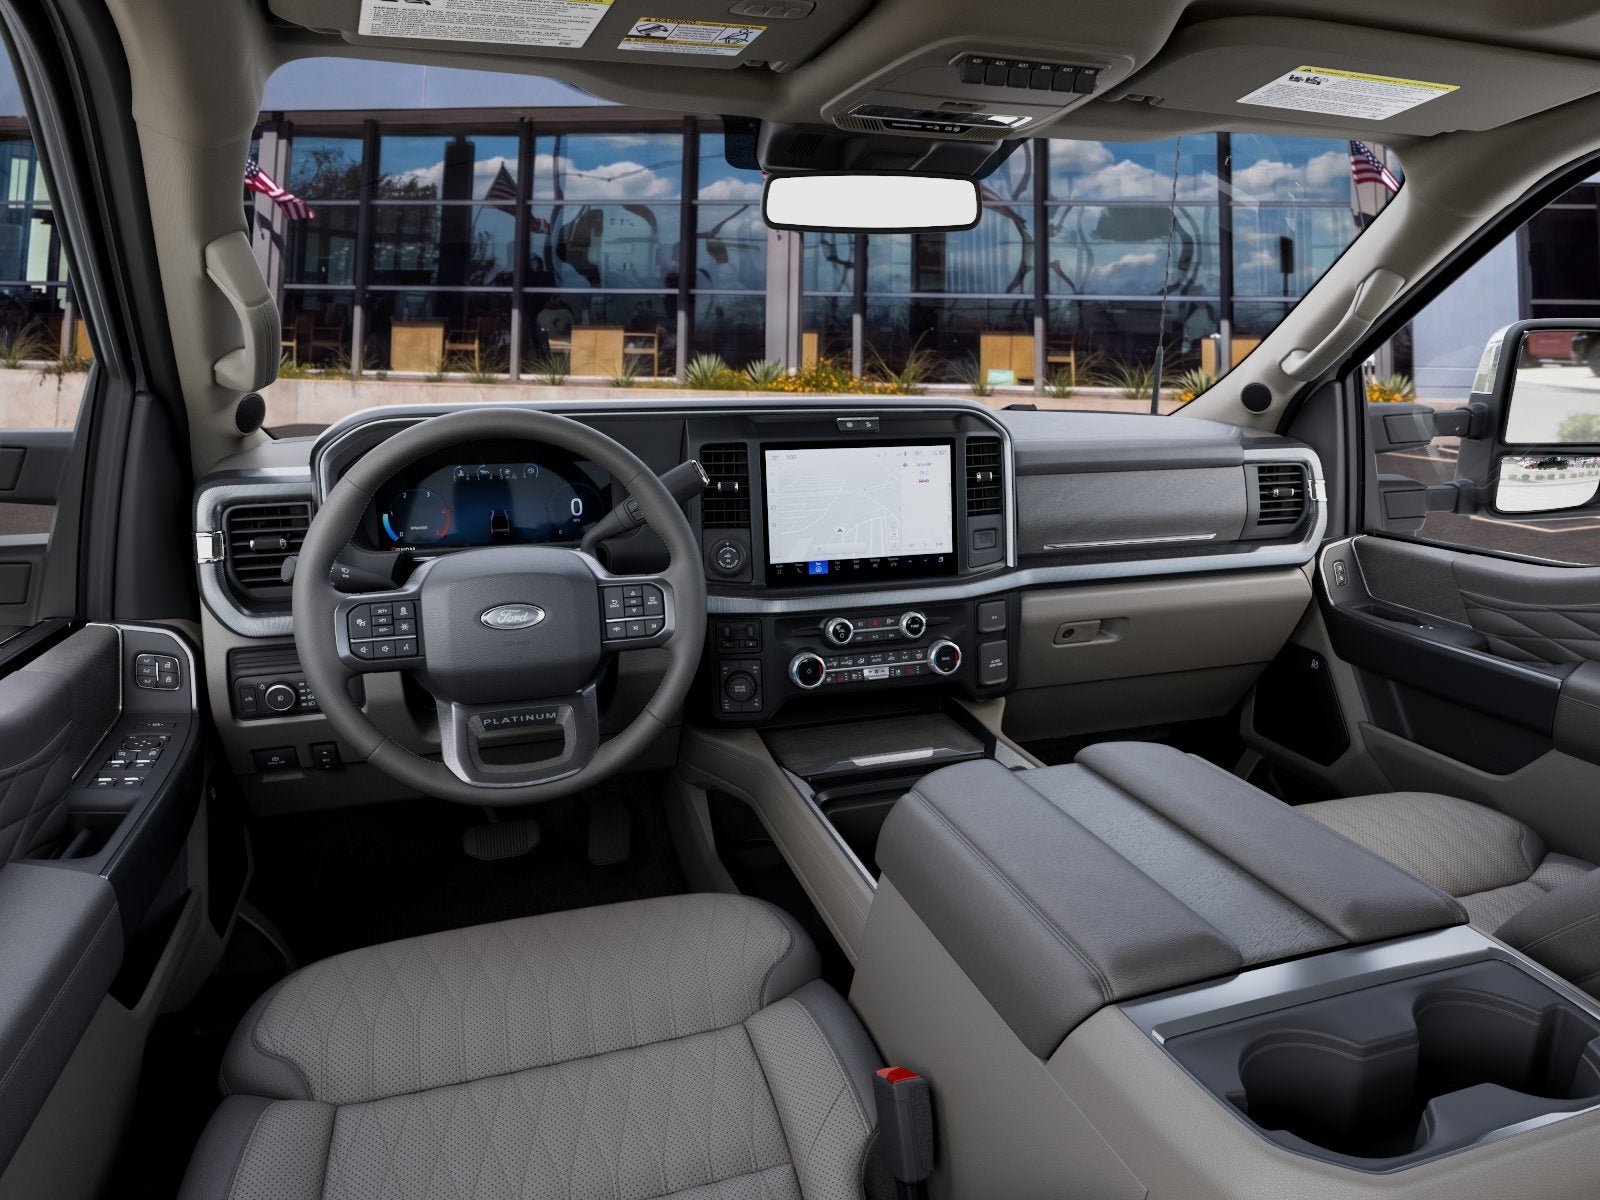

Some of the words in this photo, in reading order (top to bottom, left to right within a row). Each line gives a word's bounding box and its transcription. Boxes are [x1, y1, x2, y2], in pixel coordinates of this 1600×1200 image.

[570, 497, 583, 516] 0
[498, 609, 529, 623] Ford
[483, 712, 557, 725] PLATINUM
